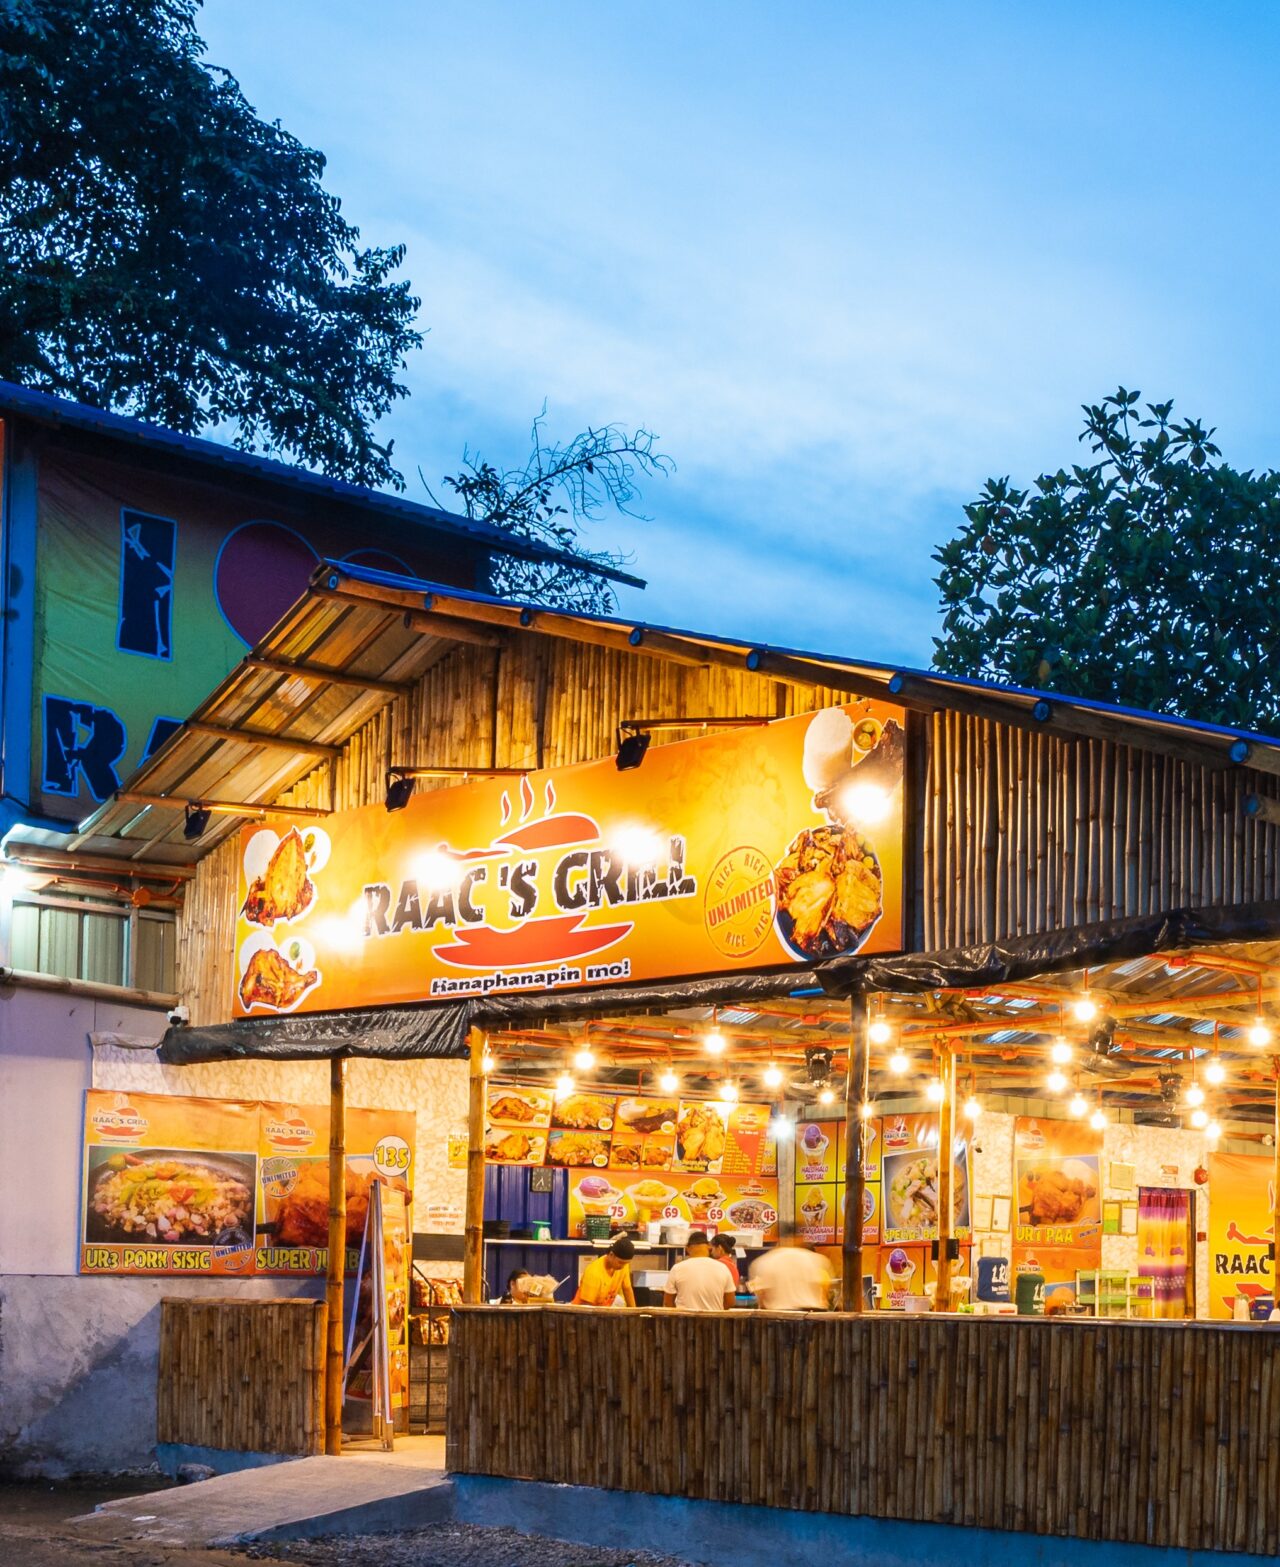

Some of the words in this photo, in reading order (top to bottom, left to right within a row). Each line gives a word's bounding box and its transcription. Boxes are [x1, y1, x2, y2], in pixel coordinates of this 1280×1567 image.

[553, 836, 697, 911] GRILL
[715, 859, 735, 889] RICE
[744, 853, 765, 875] RICE
[708, 879, 773, 926] UNLIMITED
[754, 907, 771, 938] RICE
[725, 931, 746, 948] RICE
[431, 967, 580, 994] Hanaphanapin
[587, 961, 631, 979] mo!
[375, 1145, 409, 1168] 135
[262, 1171, 297, 1184] UNLIMITED
[611, 1206, 624, 1218] 75
[664, 1207, 678, 1218] 69
[709, 1208, 723, 1220] 69
[763, 1210, 776, 1222] 45
[1046, 1227, 1073, 1243] PAA
[85, 1248, 119, 1269] UR3
[124, 1248, 168, 1269] PORK
[172, 1250, 212, 1270] SISIG
[257, 1247, 311, 1270] SUPER
